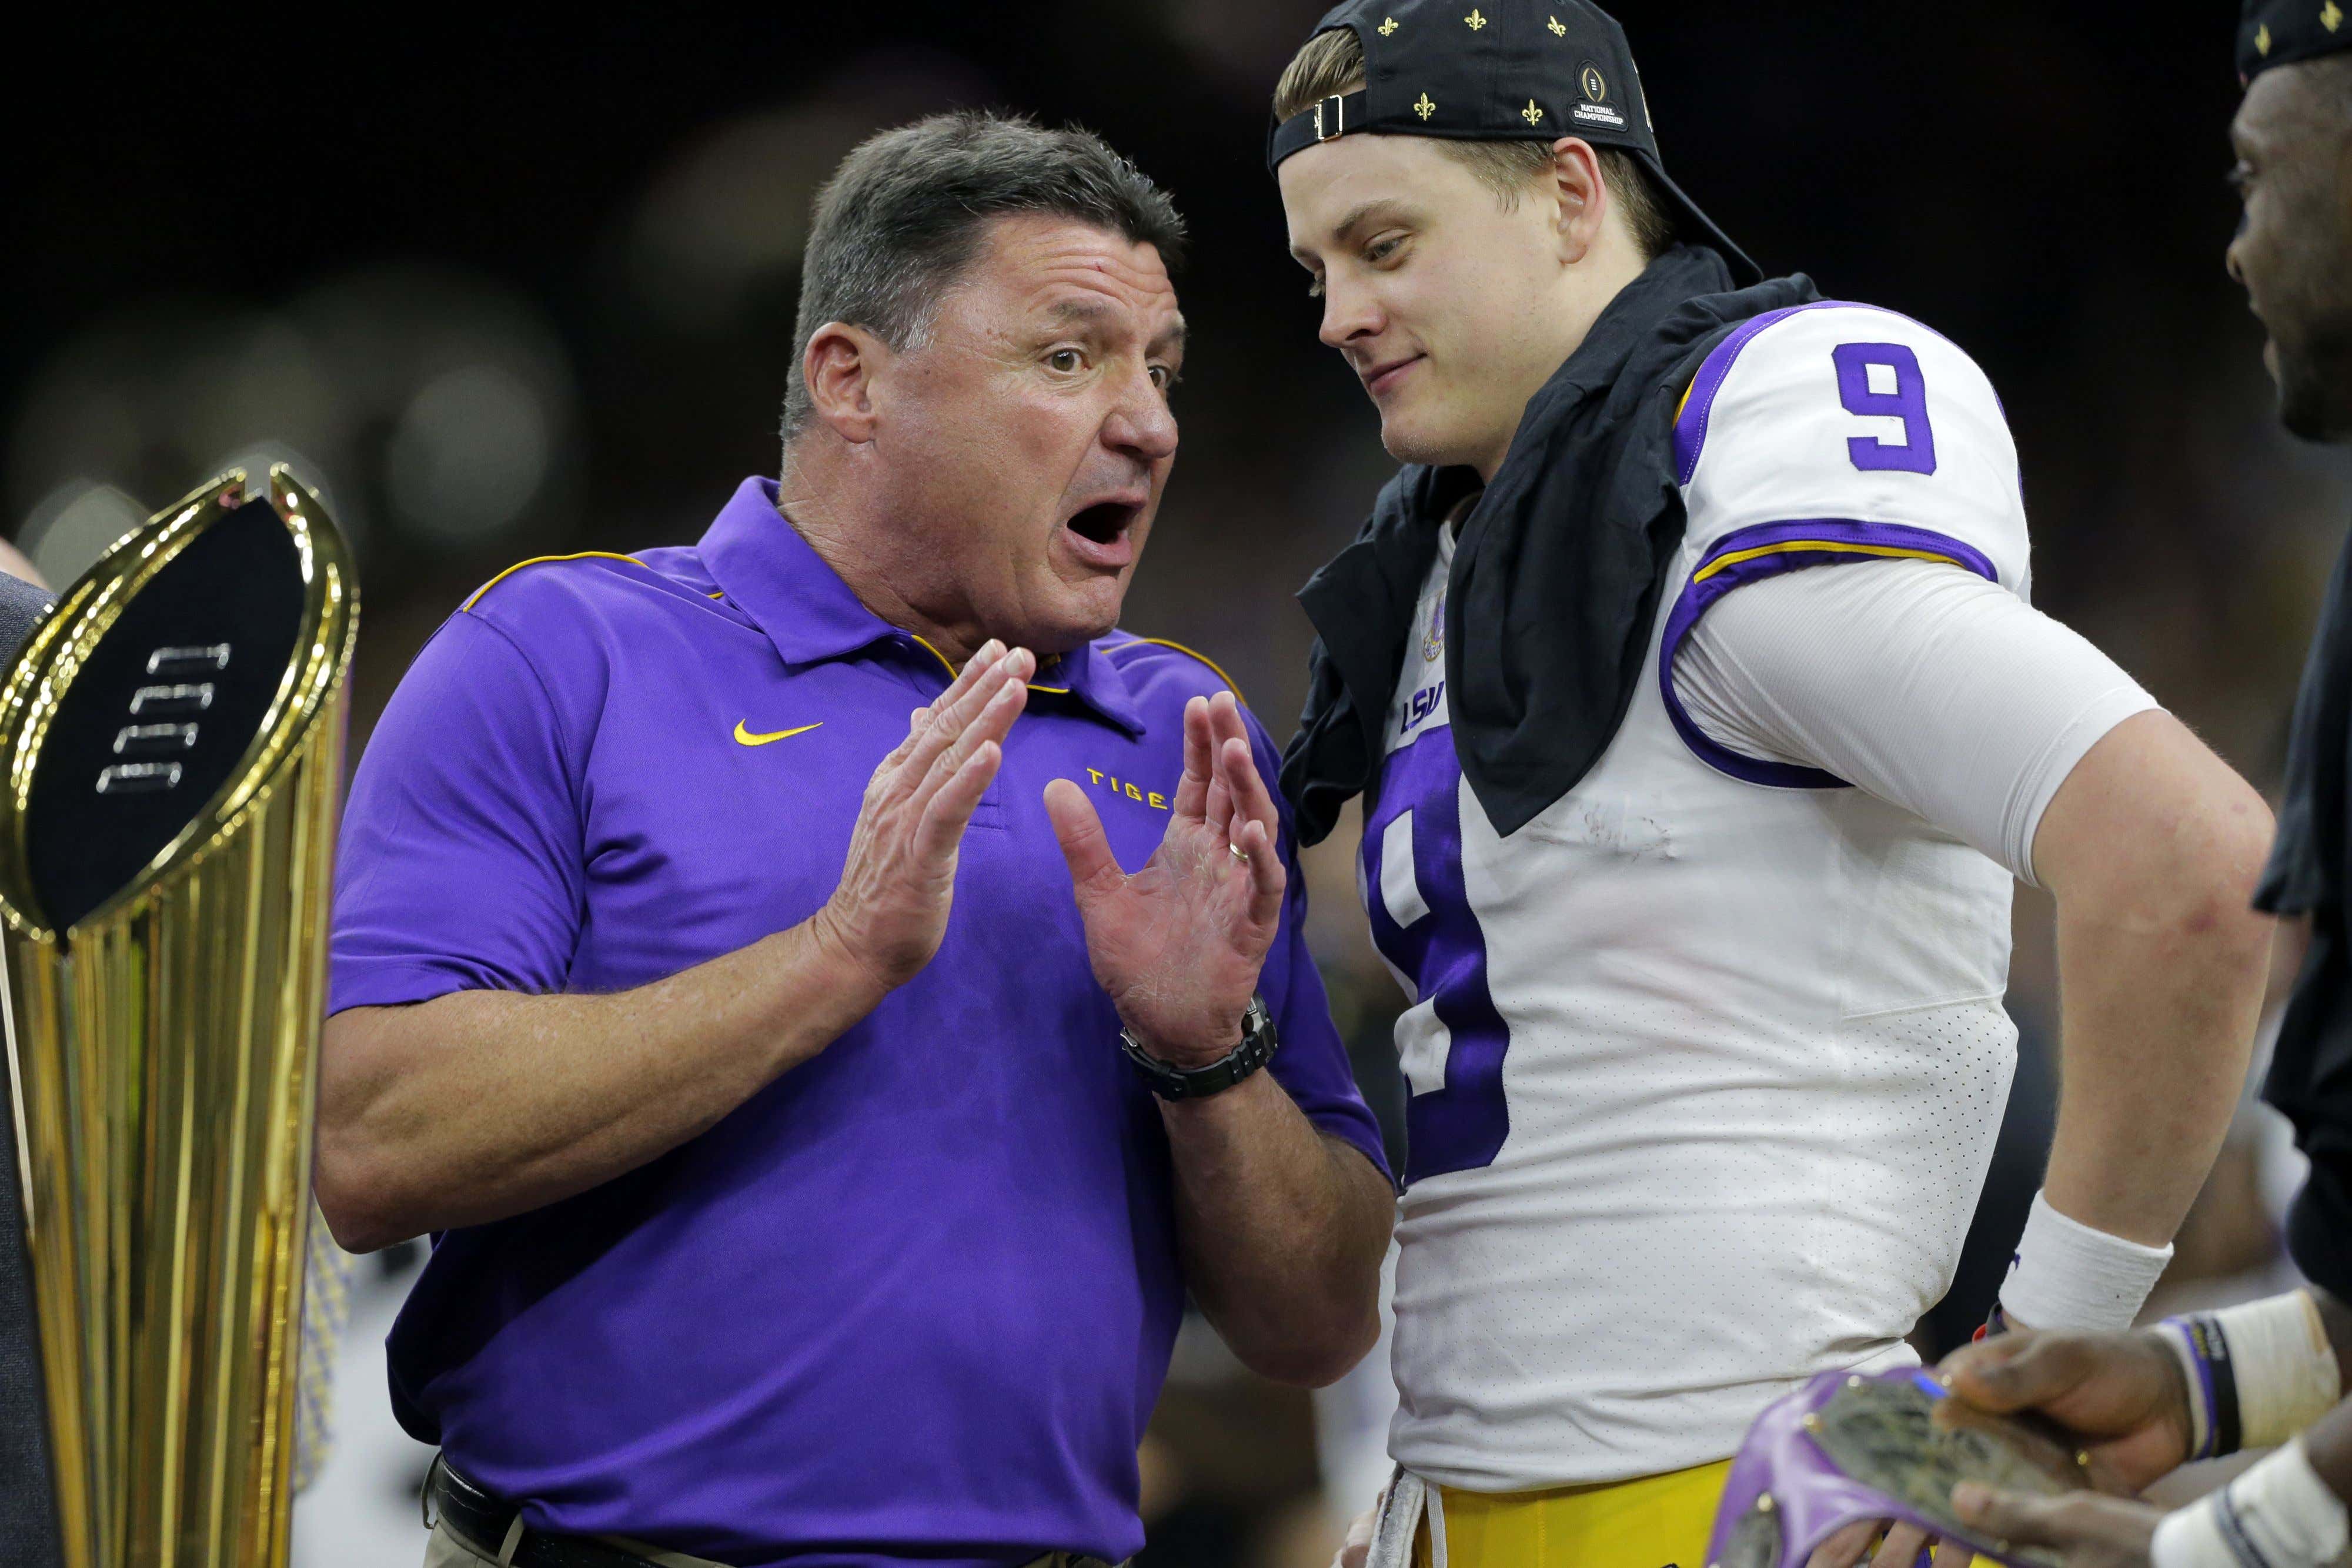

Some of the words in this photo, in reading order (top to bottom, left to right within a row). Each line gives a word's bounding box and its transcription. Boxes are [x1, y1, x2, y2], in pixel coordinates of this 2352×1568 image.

[1574, 110, 1623, 125] CHAMPIONSHIP
[1580, 103, 1615, 116] NATIONAL
[1831, 342, 1937, 476] 9
[1400, 680, 1445, 735] LSU
[1087, 767, 1177, 811] TIGE
